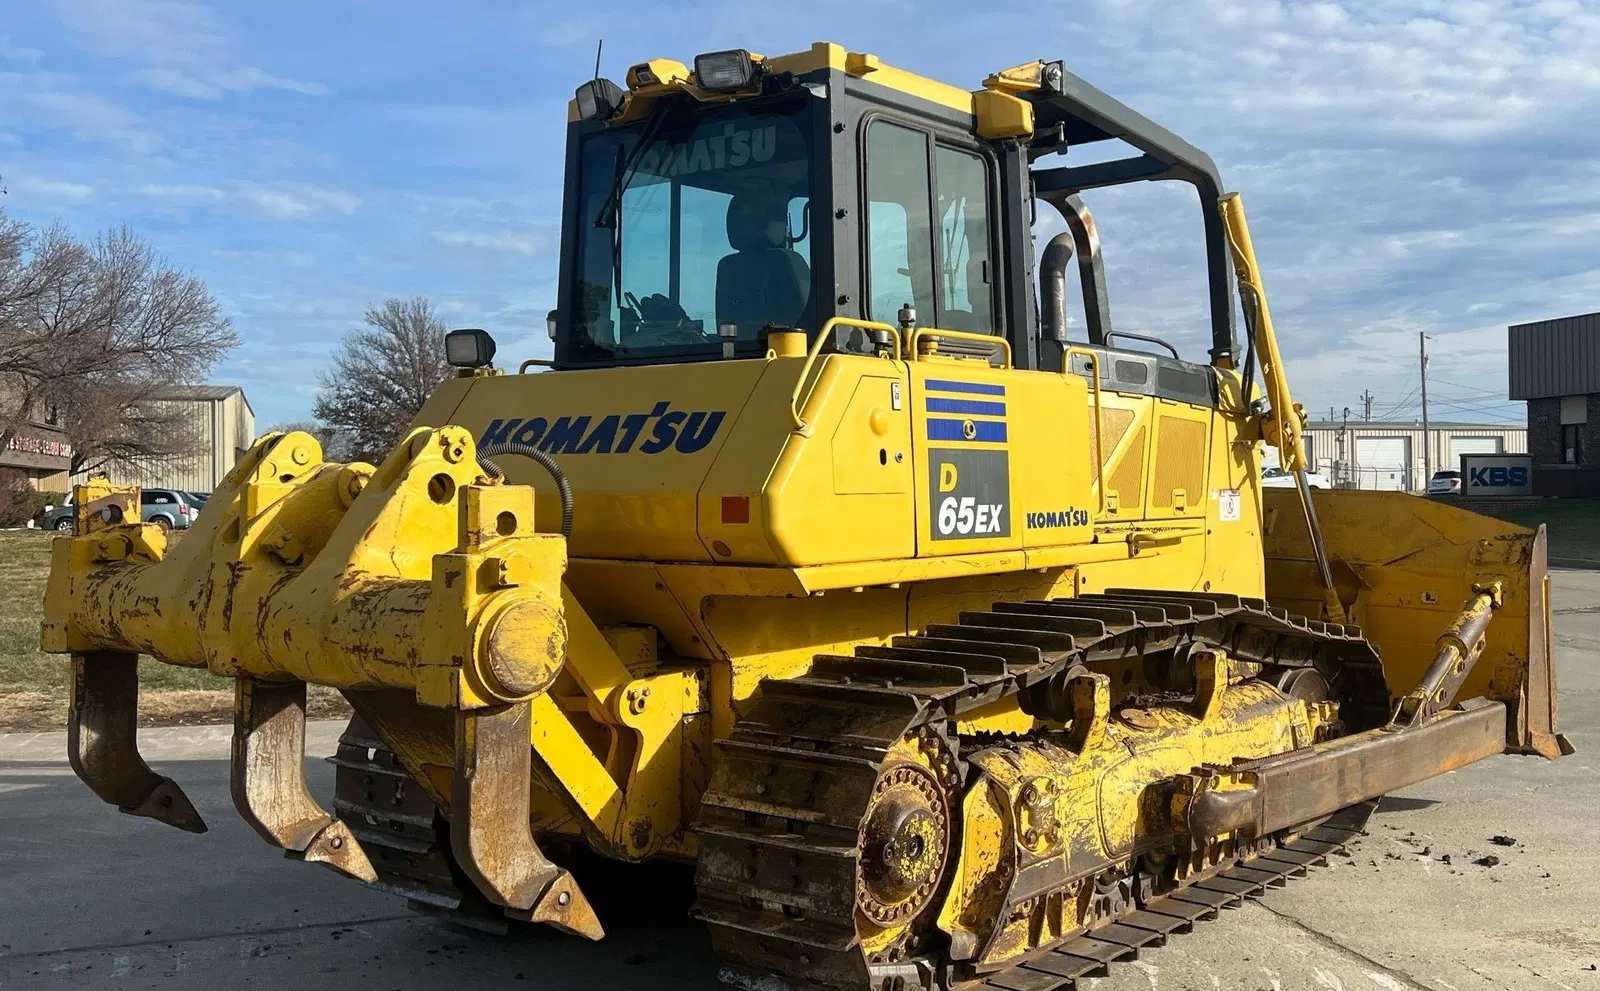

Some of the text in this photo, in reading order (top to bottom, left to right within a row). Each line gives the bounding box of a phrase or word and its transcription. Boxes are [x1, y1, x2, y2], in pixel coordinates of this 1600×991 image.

[626, 122, 776, 178] OMATSU
[478, 401, 727, 455] KOMATSU
[939, 462, 958, 492] D
[1470, 466, 1529, 487] KBS
[938, 496, 1003, 535] 65EX
[1026, 505, 1088, 529] KOMATSU
